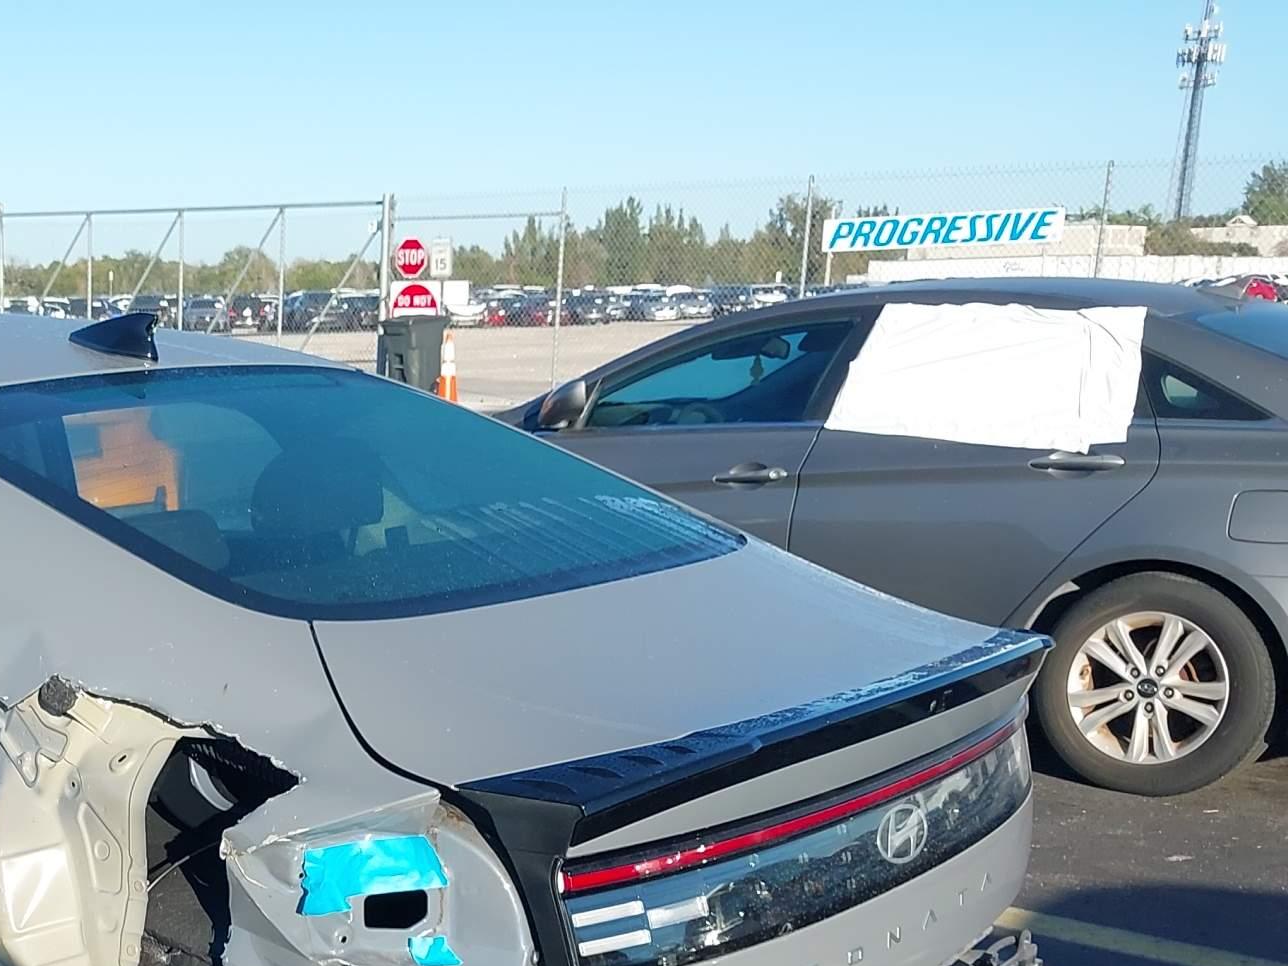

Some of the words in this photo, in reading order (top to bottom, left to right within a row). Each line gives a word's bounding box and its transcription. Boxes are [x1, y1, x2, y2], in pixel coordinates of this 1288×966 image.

[829, 210, 1058, 248] PROGRESSIVE
[398, 248, 425, 266] STOP
[435, 258, 447, 271] 15
[397, 294, 411, 307] DO
[413, 294, 432, 307] NOT
